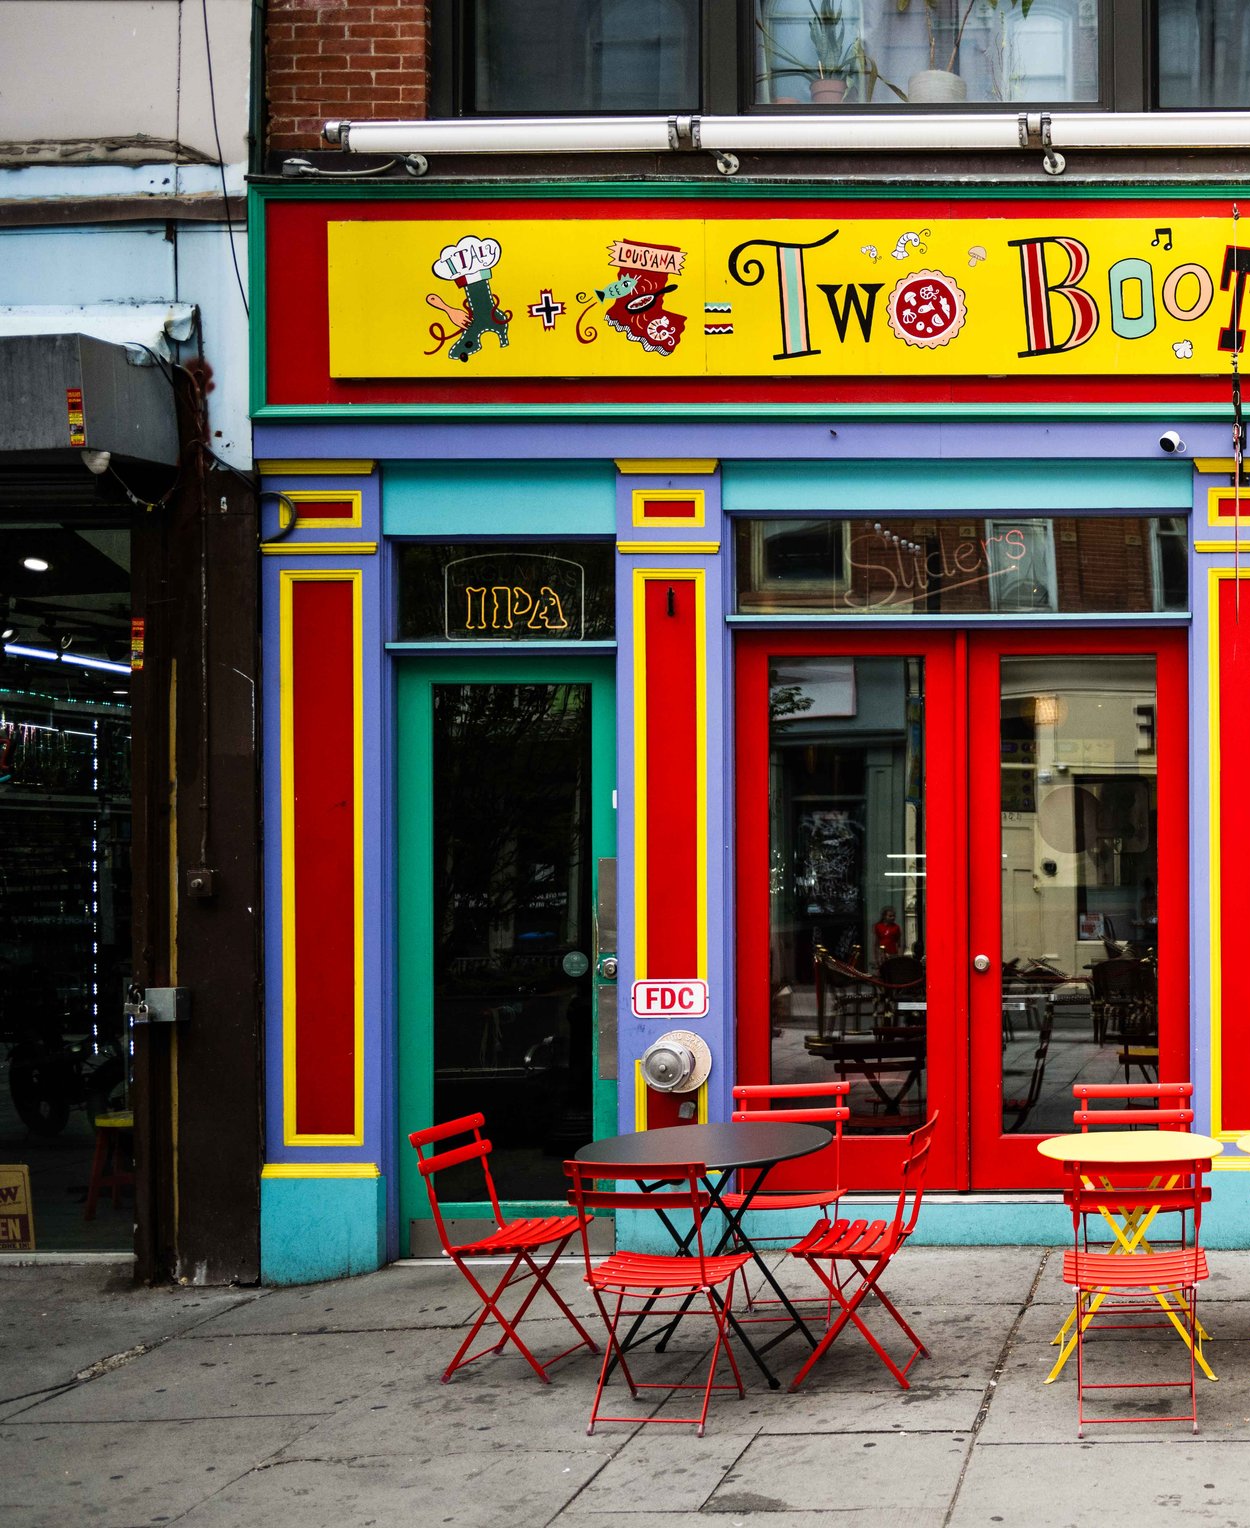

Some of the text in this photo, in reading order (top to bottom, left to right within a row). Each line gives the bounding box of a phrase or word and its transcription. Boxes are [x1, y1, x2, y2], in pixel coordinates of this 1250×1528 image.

[440, 244, 497, 278] ITALY
[466, 586, 568, 629] IPA
[646, 987, 694, 1010] FDC
